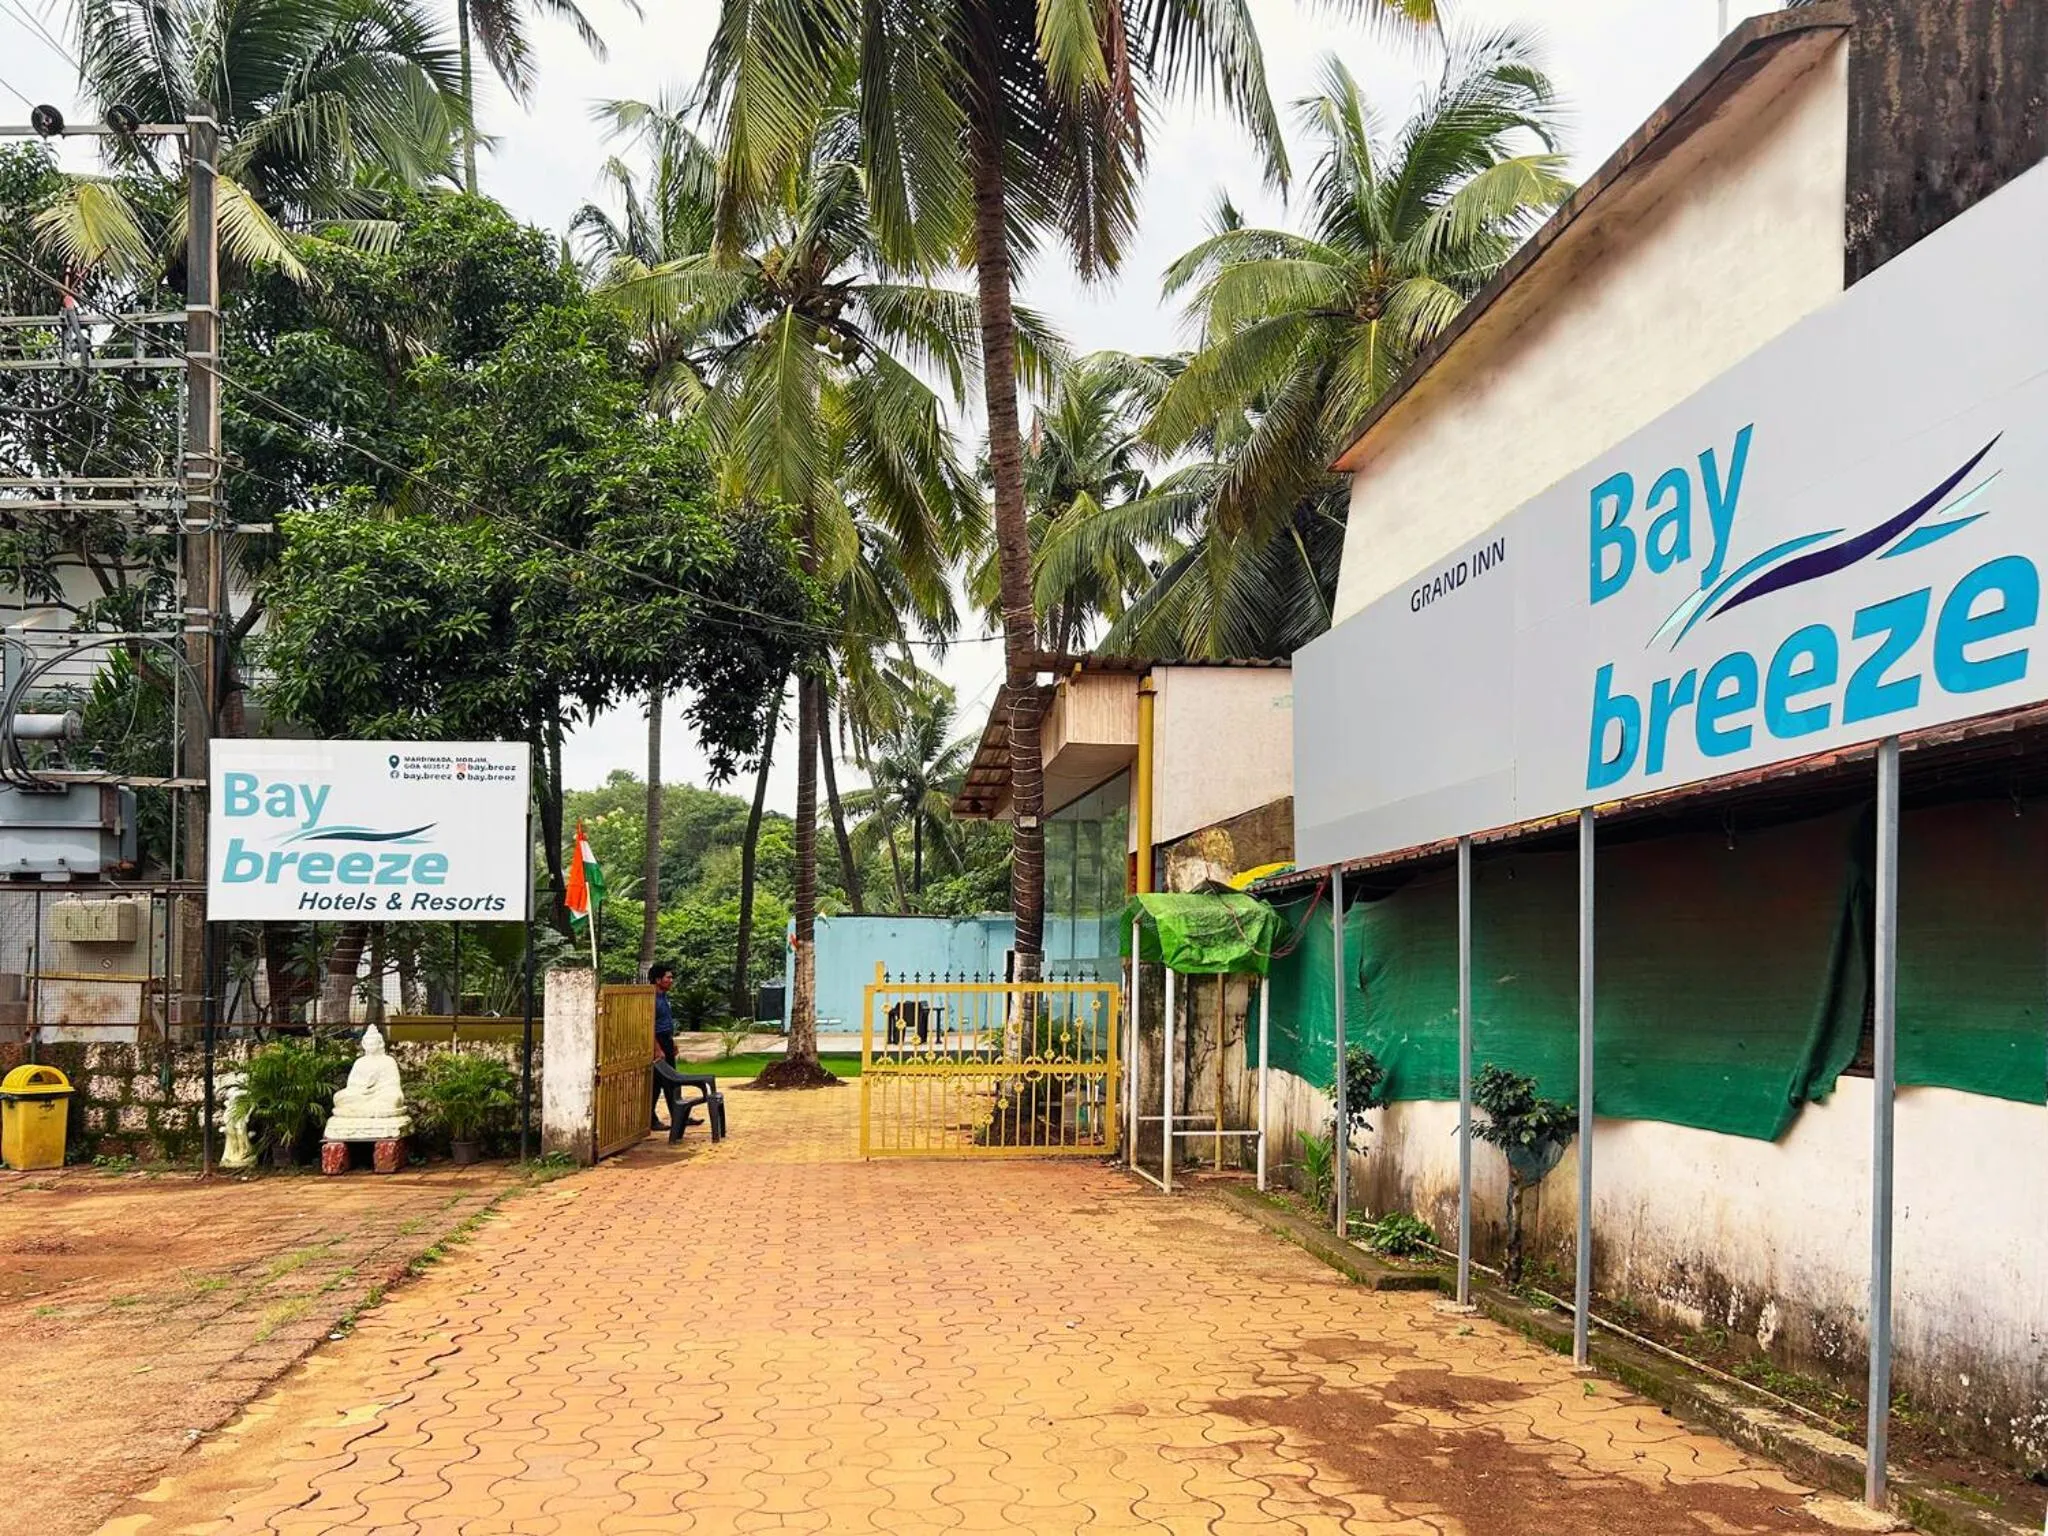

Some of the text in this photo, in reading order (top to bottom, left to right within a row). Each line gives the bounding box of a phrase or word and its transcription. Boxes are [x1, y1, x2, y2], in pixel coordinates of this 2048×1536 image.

[1588, 423, 1755, 605] Bay
[1410, 536, 1506, 613] GRAND INN
[1586, 554, 2042, 792] breeze
[224, 772, 332, 828] Bay
[221, 837, 449, 886] breeze
[298, 891, 506, 912] Hotels & Resorts
